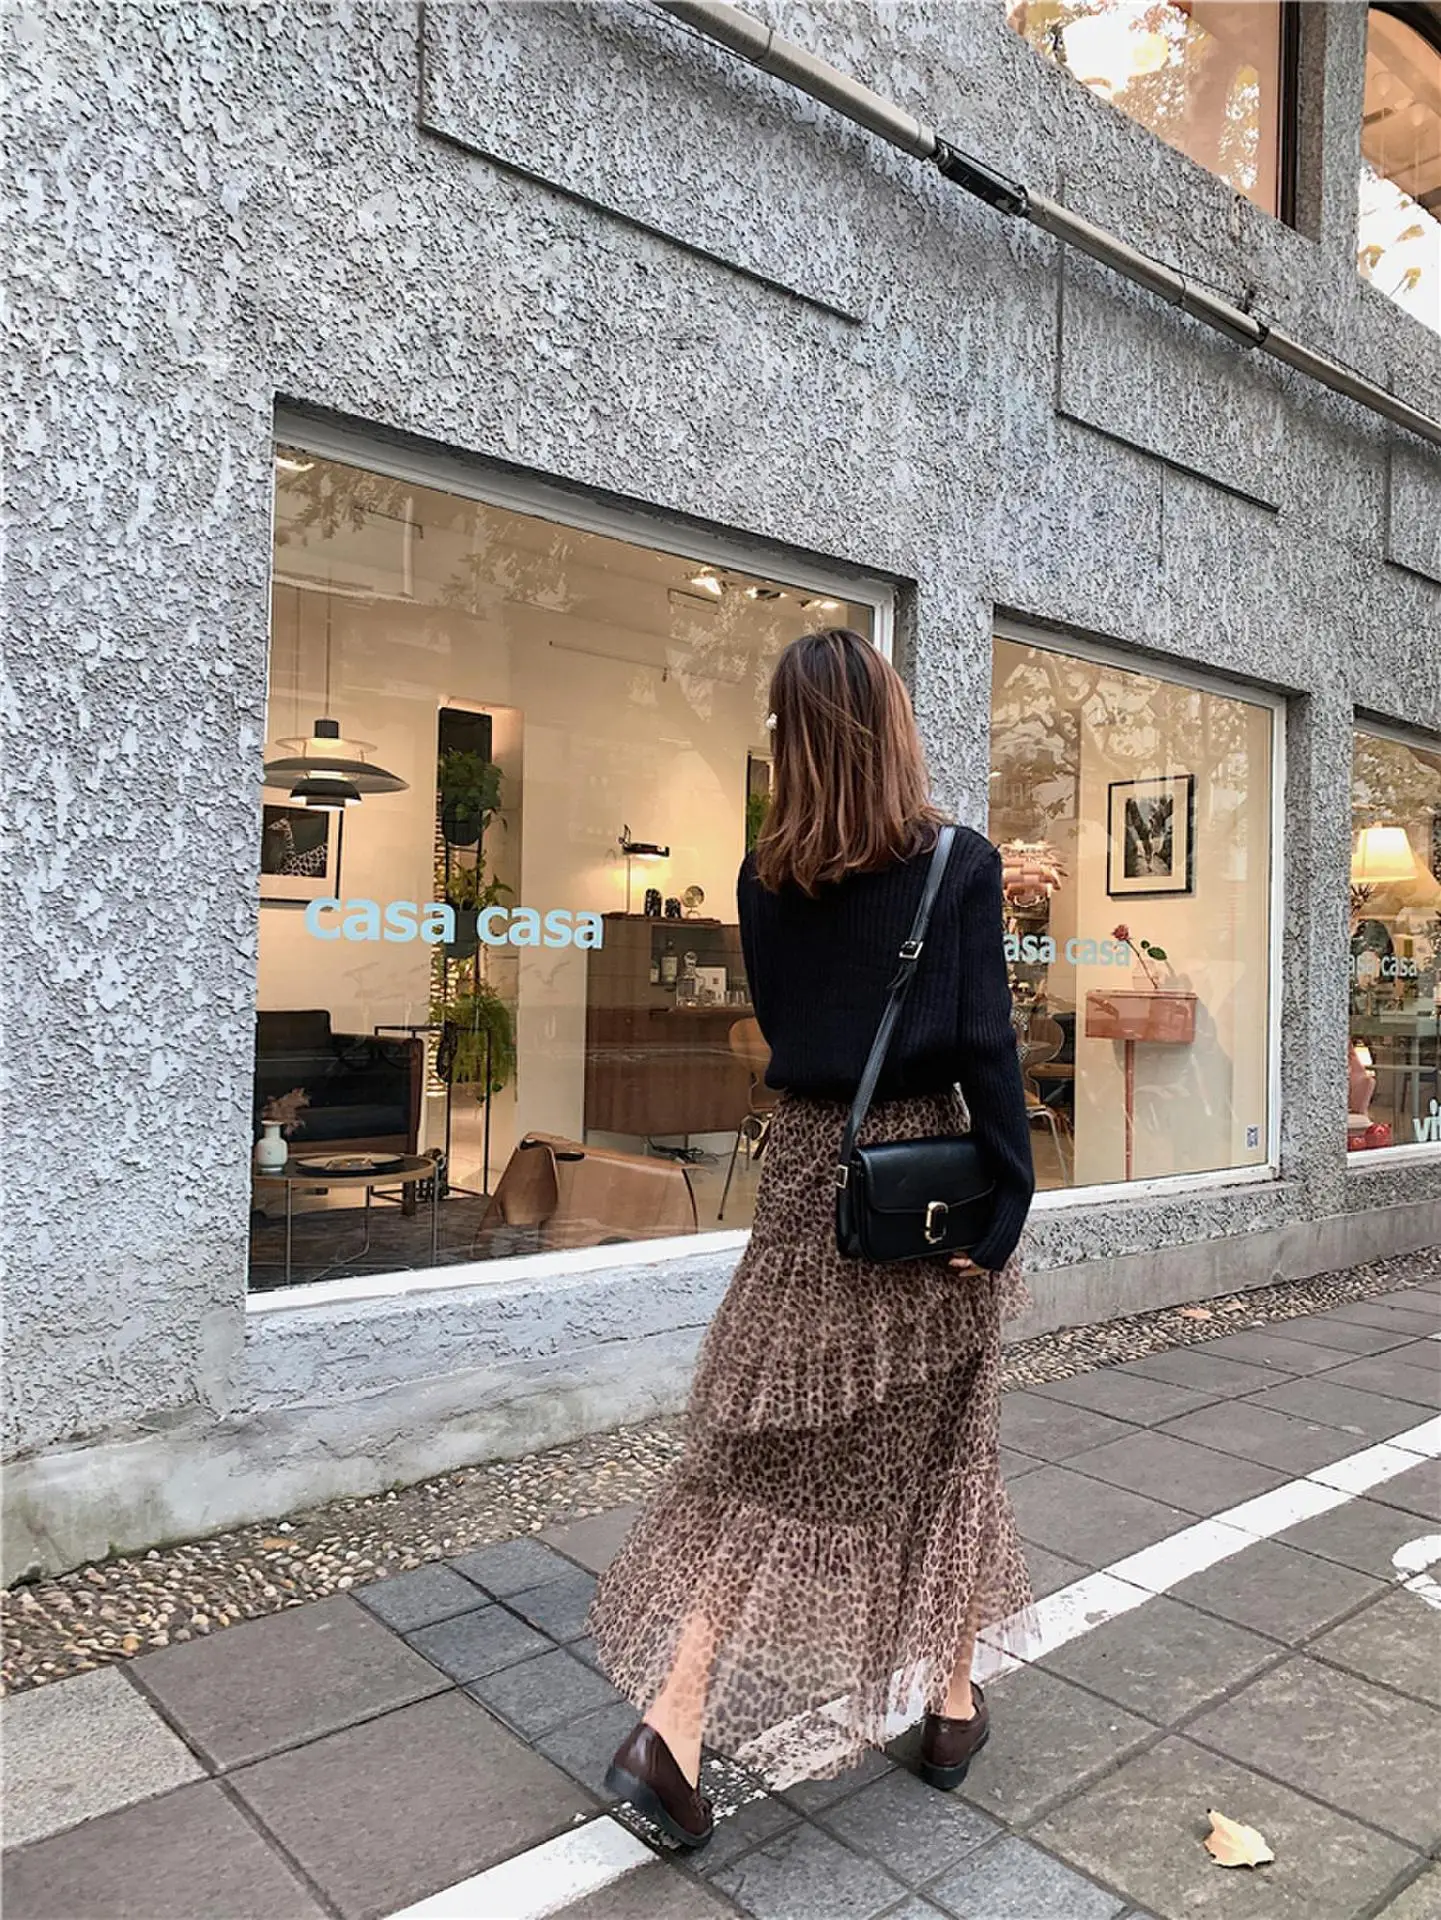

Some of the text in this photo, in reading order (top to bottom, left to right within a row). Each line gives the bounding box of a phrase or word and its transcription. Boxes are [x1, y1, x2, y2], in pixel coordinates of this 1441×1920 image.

[305, 897, 604, 950] casa casa
[1003, 934, 1130, 967] asa casa
[1381, 956, 1417, 977] casa
